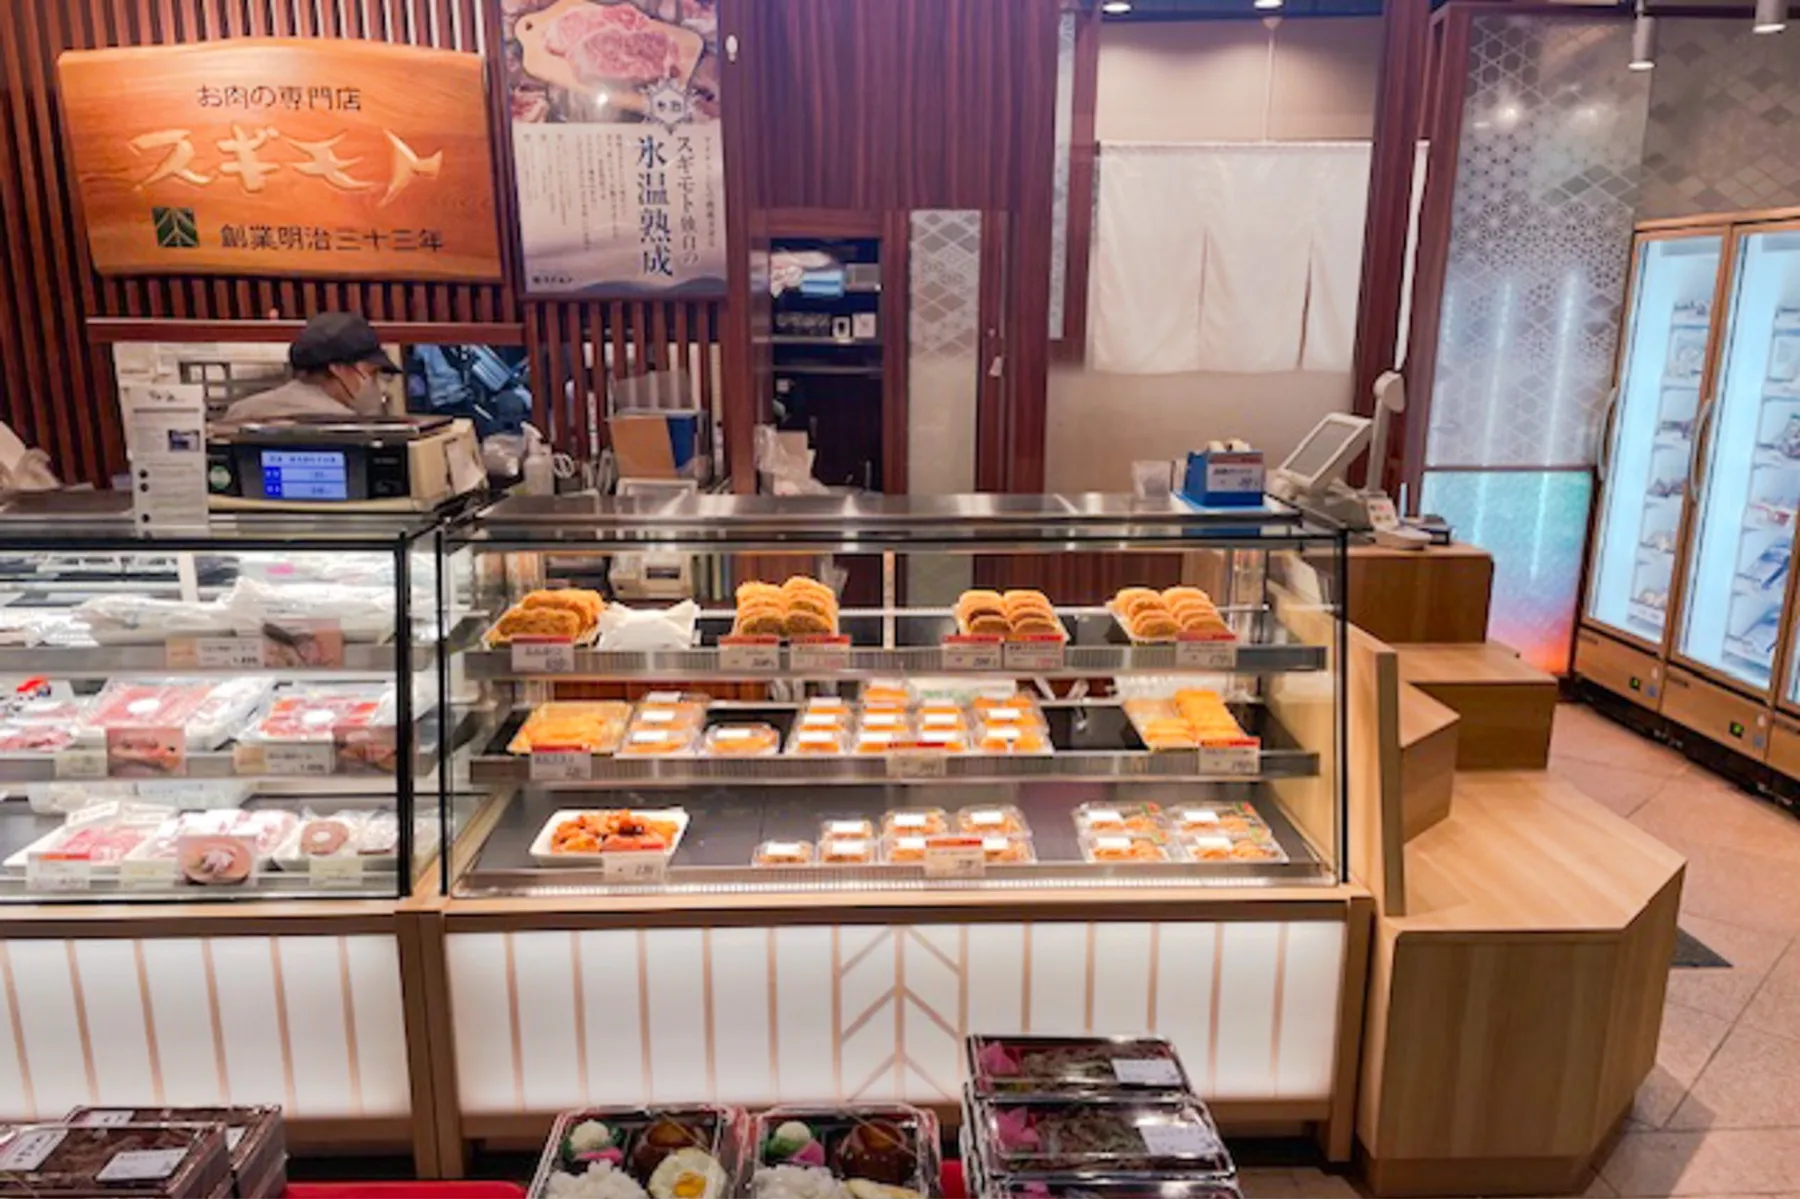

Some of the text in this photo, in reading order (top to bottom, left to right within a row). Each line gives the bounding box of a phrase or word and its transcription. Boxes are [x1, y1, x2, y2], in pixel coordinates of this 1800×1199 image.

[197, 85, 362, 111] お肉の専門店
[127, 122, 444, 209] スギモト
[636, 133, 674, 278] 氷温熟成
[219, 223, 444, 251] 創業明治三十三年
